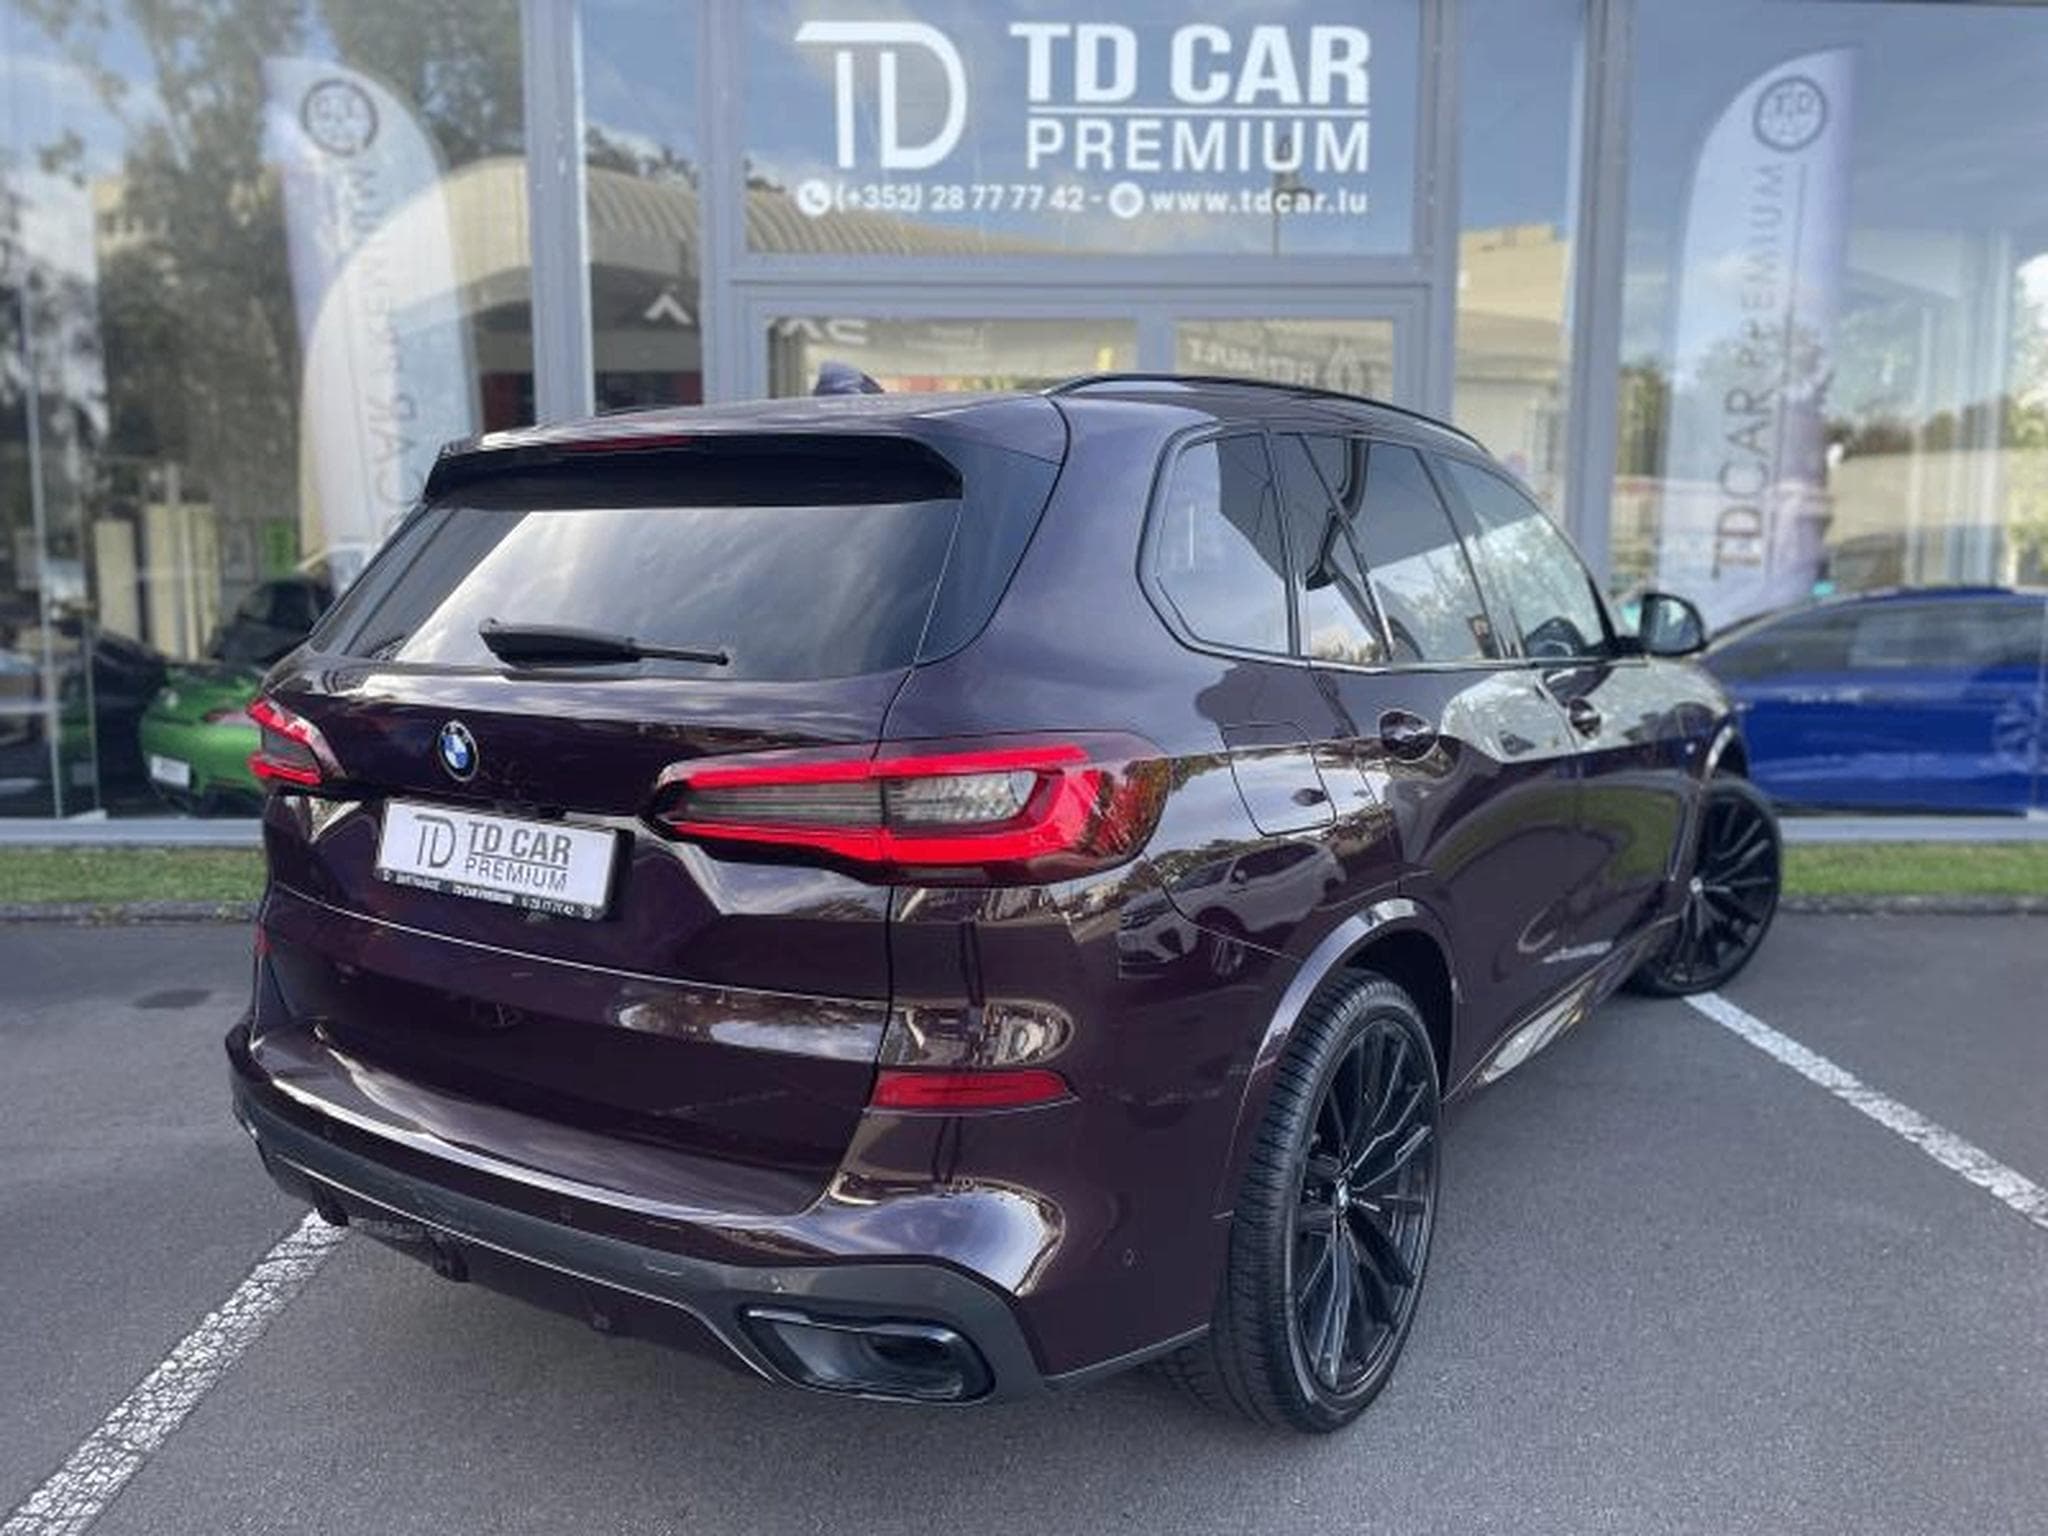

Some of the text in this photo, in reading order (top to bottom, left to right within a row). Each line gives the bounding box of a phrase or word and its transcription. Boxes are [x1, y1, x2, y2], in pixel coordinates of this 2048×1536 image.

[1010, 23, 1372, 104] TD CAR
[1026, 117, 1371, 173] PREMIUM
[836, 182, 923, 213] (+352)
[930, 184, 964, 212] 28
[970, 184, 1003, 212] 77
[1010, 184, 1044, 212] 77
[1050, 184, 1084, 212] 42
[1151, 187, 1368, 214] www.tdcar.lu
[468, 821, 572, 866] TD CAR
[465, 855, 567, 893] PREMIUM
